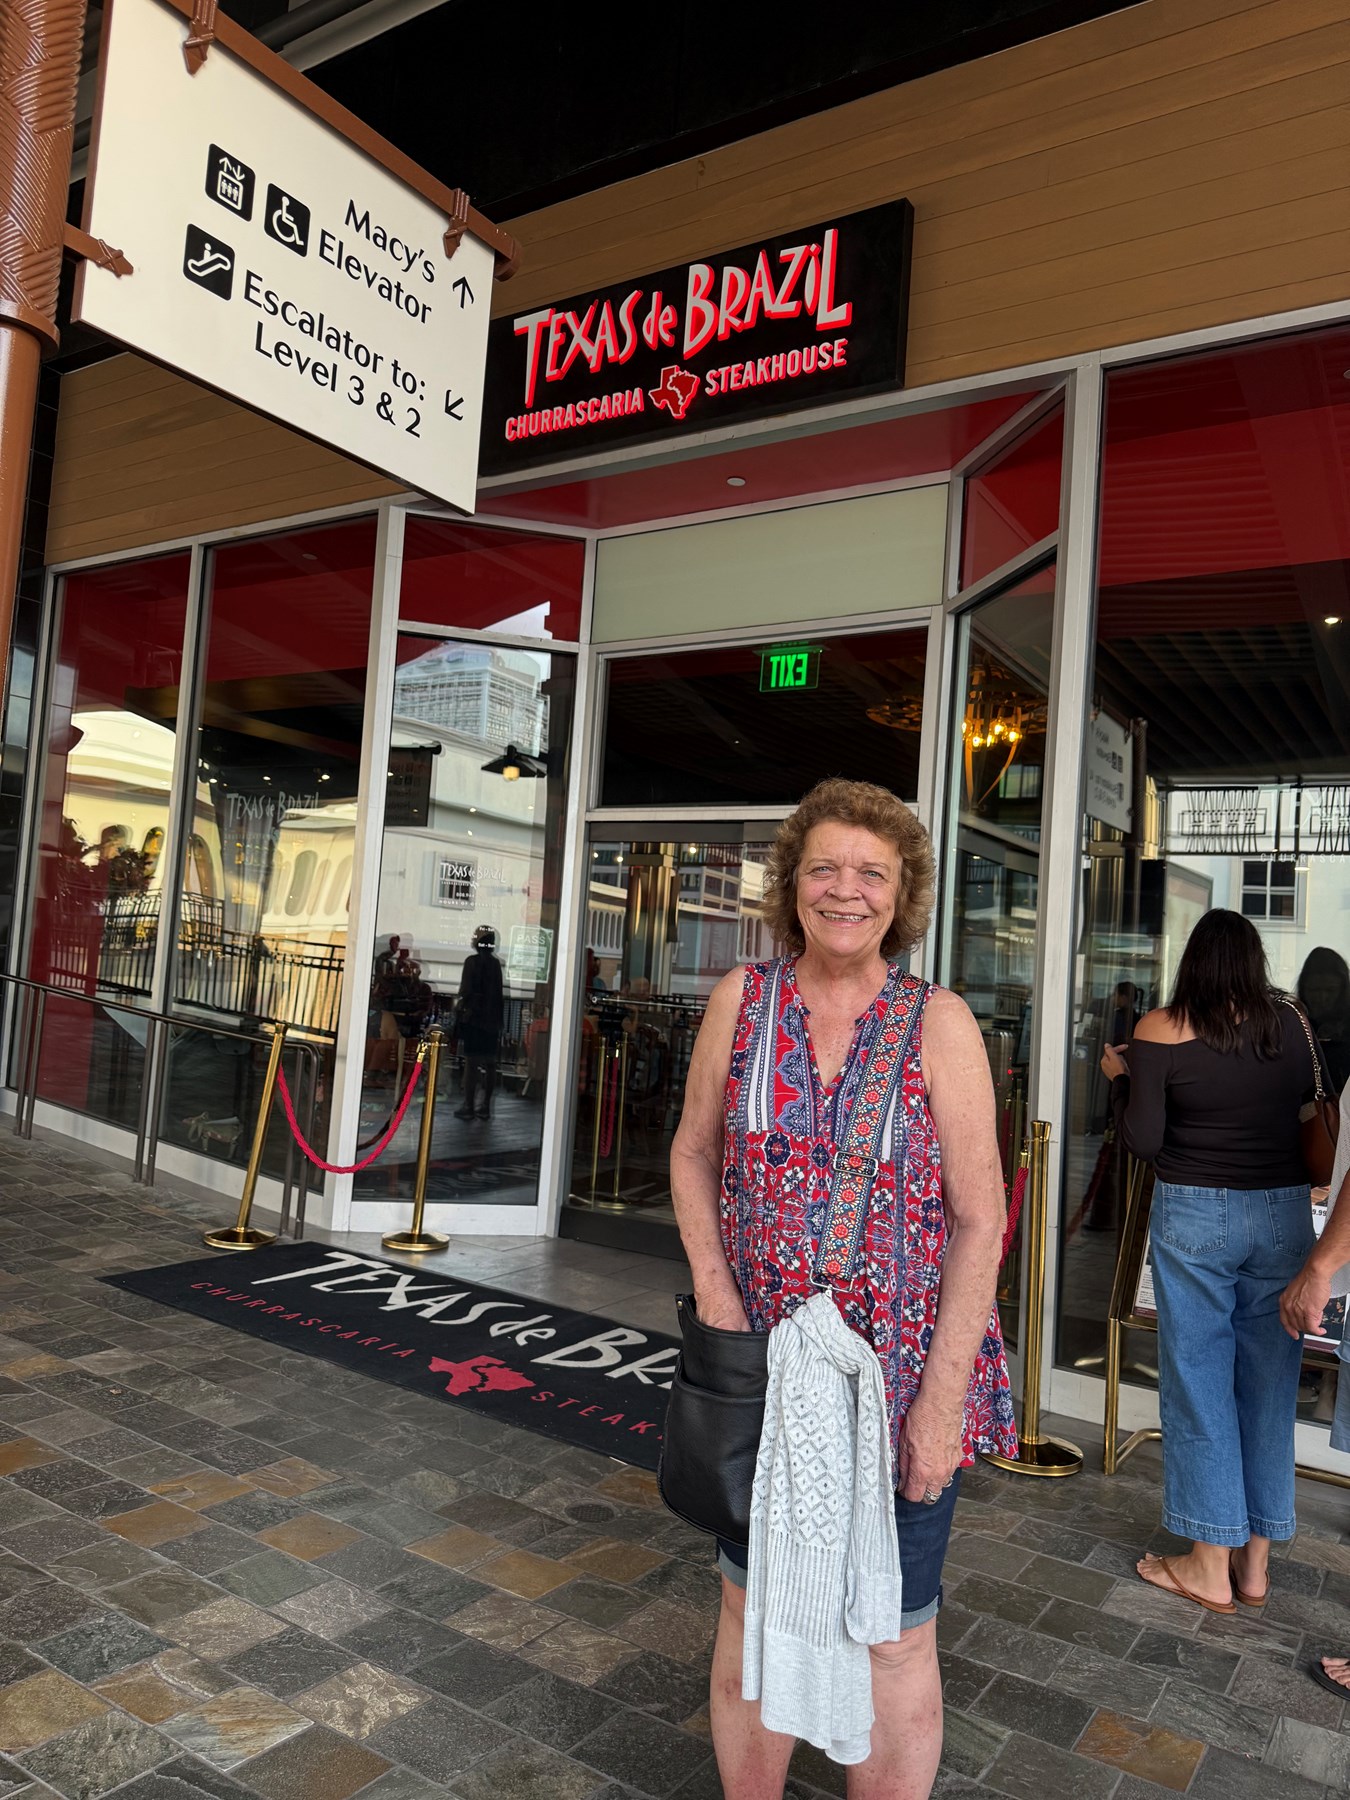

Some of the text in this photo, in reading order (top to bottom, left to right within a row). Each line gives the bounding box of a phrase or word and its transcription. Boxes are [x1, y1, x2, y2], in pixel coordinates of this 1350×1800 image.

[318, 228, 432, 324] Elevator
[344, 199, 436, 283] Macy's
[243, 269, 426, 401] Escalator to:
[255, 320, 421, 439] Level 3 & 2
[513, 289, 643, 408] TEXAS
[642, 291, 677, 350] de
[505, 338, 848, 442] CHURRASCARIA STEAKHOUSE
[226, 793, 265, 827] TEXAS
[440, 862, 468, 879] TEXAS
[516, 934, 546, 945] PASS
[190, 1282, 416, 1358] CHURRASCARIA
[251, 1251, 681, 1390] TEXAS de BR
[530, 1391, 663, 1440] STEAK
